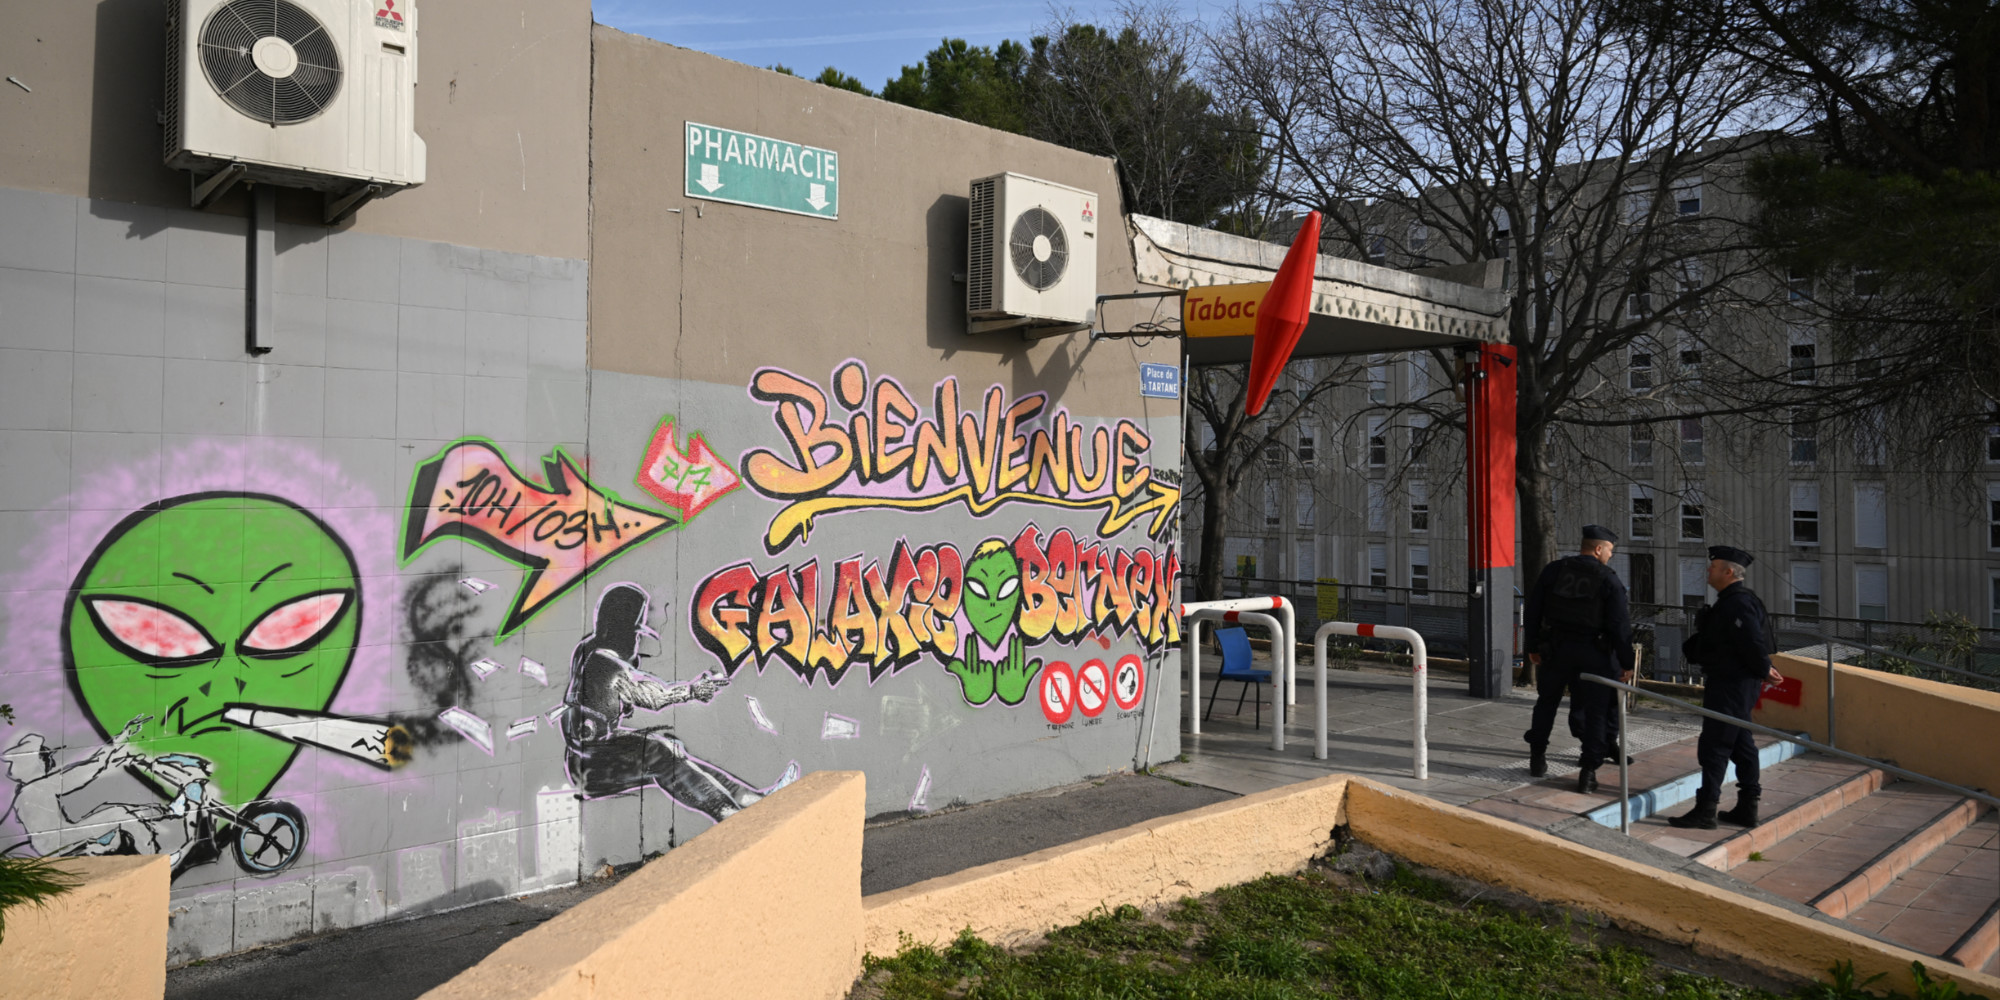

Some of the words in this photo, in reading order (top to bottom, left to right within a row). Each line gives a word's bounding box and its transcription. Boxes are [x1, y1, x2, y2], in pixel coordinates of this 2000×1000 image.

[690, 126, 835, 182] PHARMACIE
[1187, 296, 1256, 322] Tabac
[1147, 367, 1164, 379] Place
[1166, 369, 1174, 380] de
[1148, 381, 1178, 394] TARTANE
[660, 456, 712, 493] 7/7
